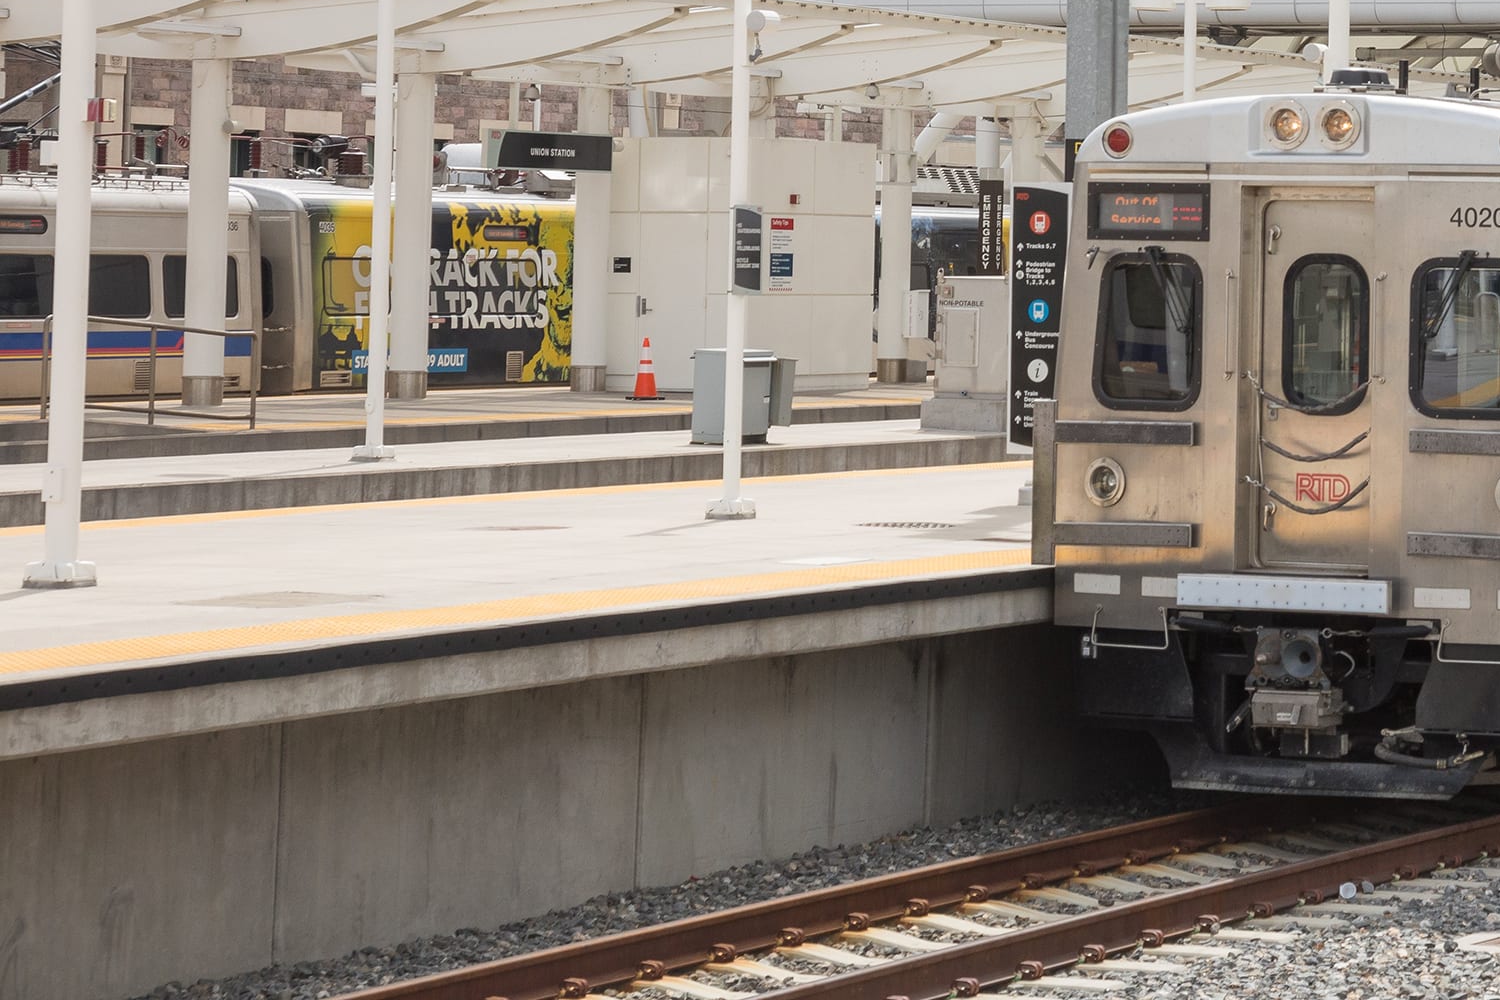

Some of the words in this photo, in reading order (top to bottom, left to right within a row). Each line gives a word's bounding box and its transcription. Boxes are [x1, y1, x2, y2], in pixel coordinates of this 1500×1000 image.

[530, 147, 549, 157] UNION
[550, 148, 576, 158] STATION
[982, 194, 991, 270] EMERGENCY
[430, 248, 499, 288] RACK
[506, 248, 560, 288] FOR
[445, 289, 549, 330] TRACKS
[437, 353, 465, 367] ADULT
[1296, 473, 1351, 502] RTD
